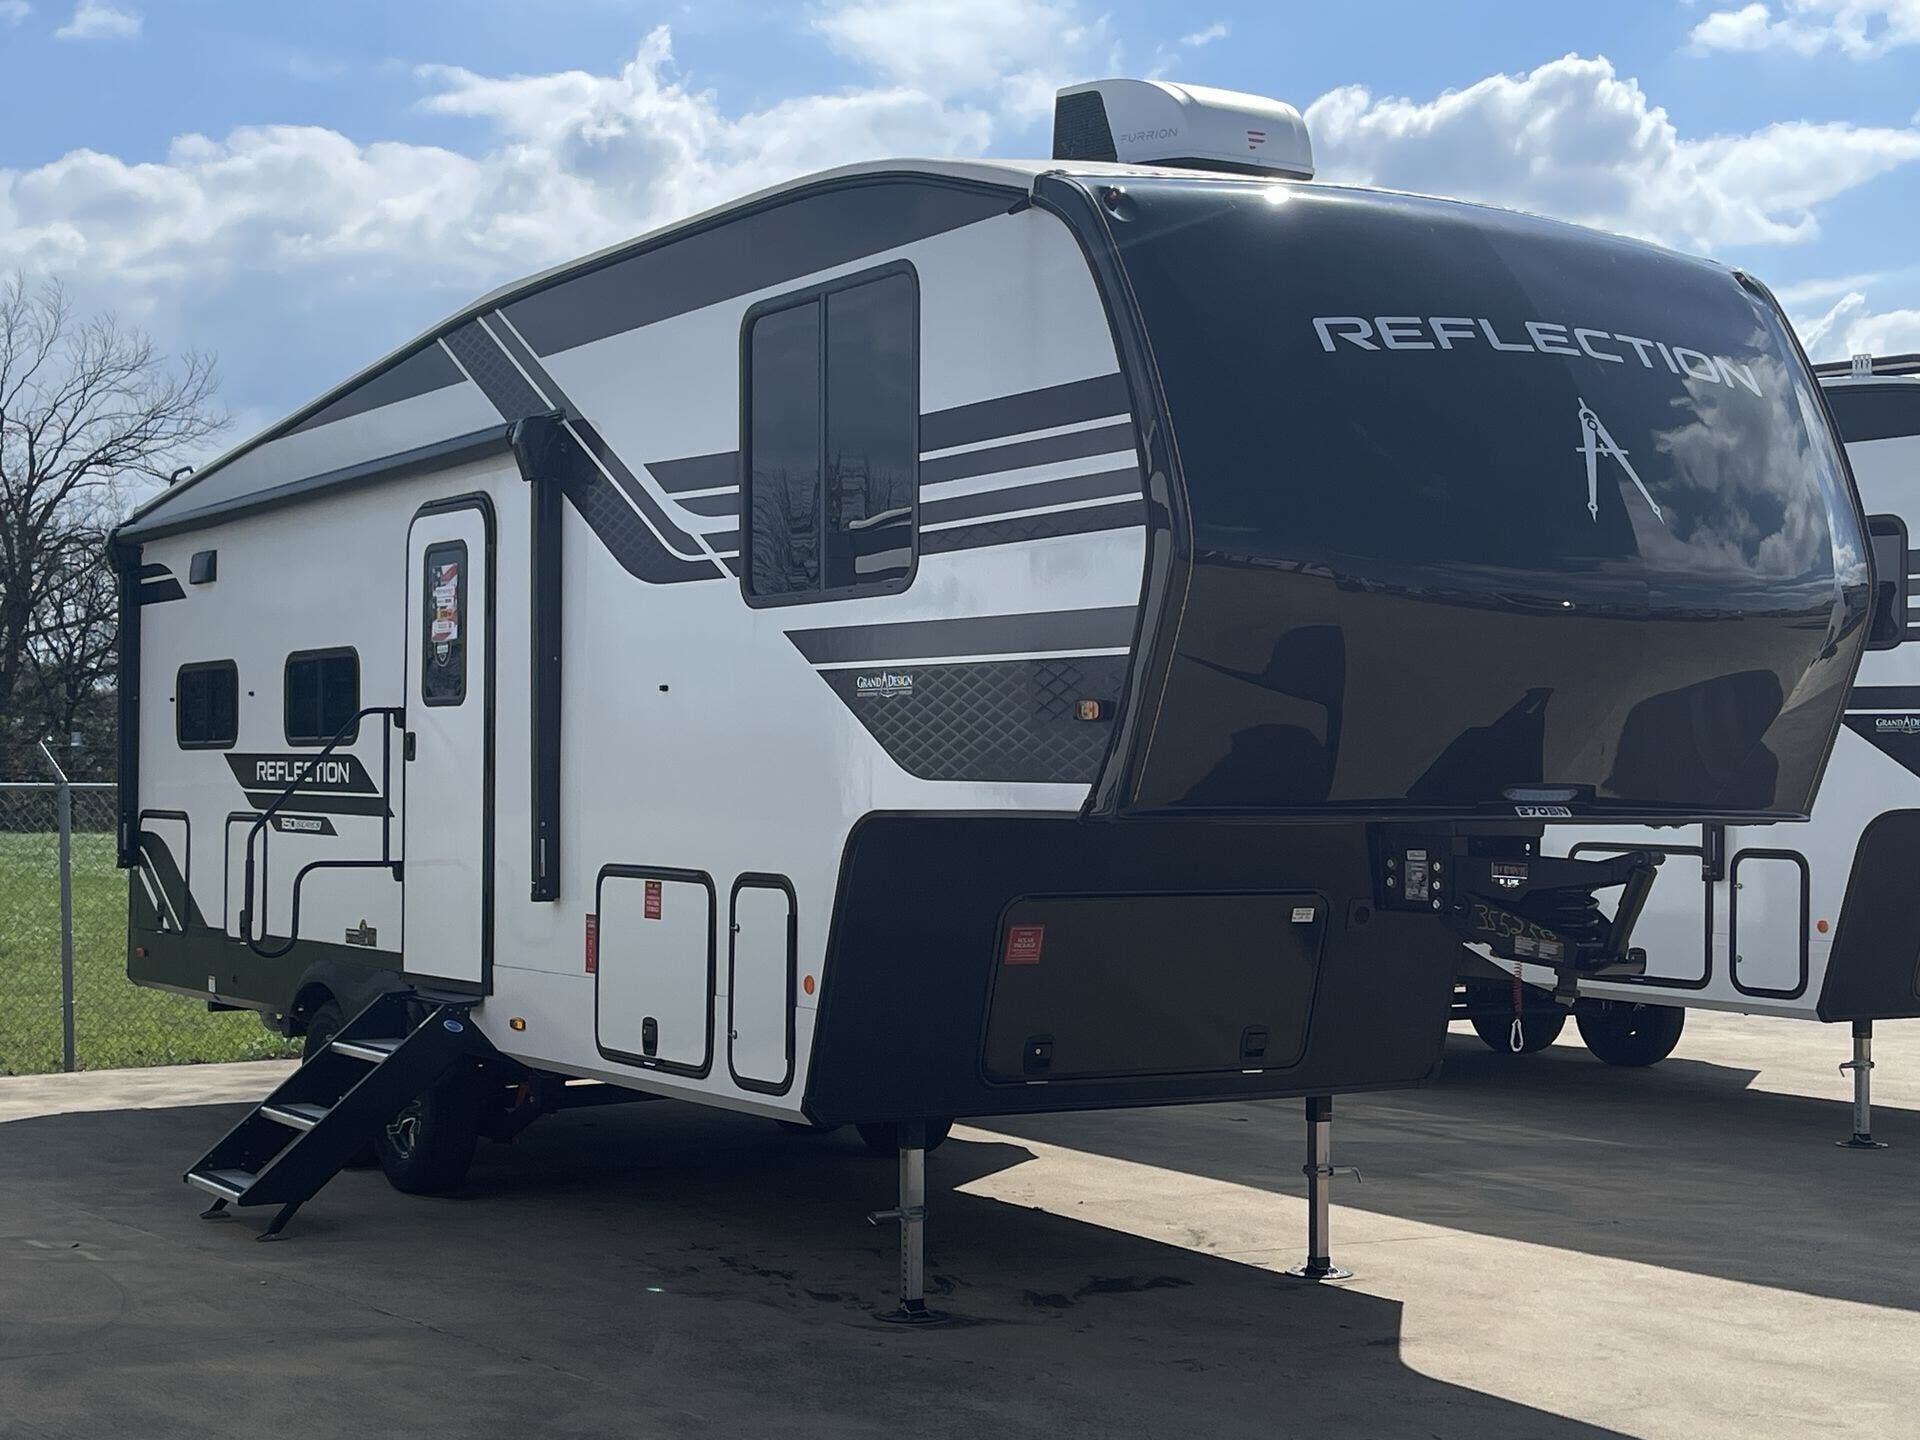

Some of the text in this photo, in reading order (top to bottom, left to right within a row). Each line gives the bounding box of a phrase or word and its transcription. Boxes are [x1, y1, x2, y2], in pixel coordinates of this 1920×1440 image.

[1120, 127, 1178, 144] FURRION
[1312, 316, 1762, 397] REFLECTION
[1518, 806, 1570, 817] 270BN
